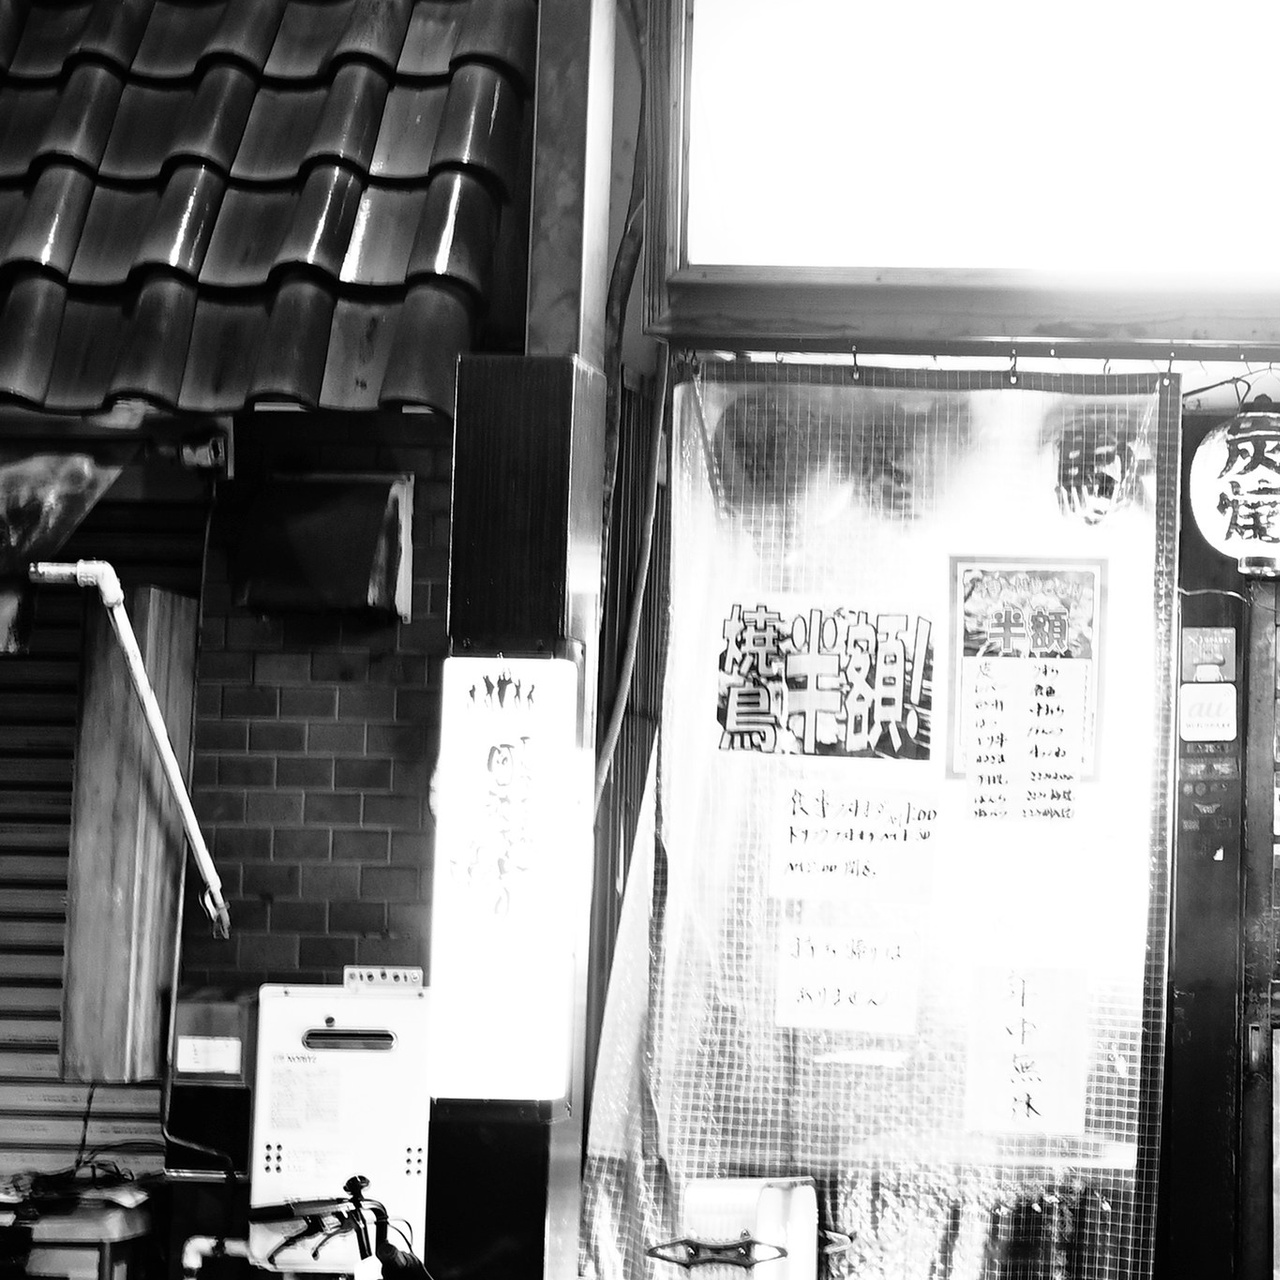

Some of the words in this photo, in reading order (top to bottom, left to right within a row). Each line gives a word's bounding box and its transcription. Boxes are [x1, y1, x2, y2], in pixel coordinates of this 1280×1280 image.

[988, 606, 1070, 655] 半額
[1004, 968, 1044, 1121] 年中無休
